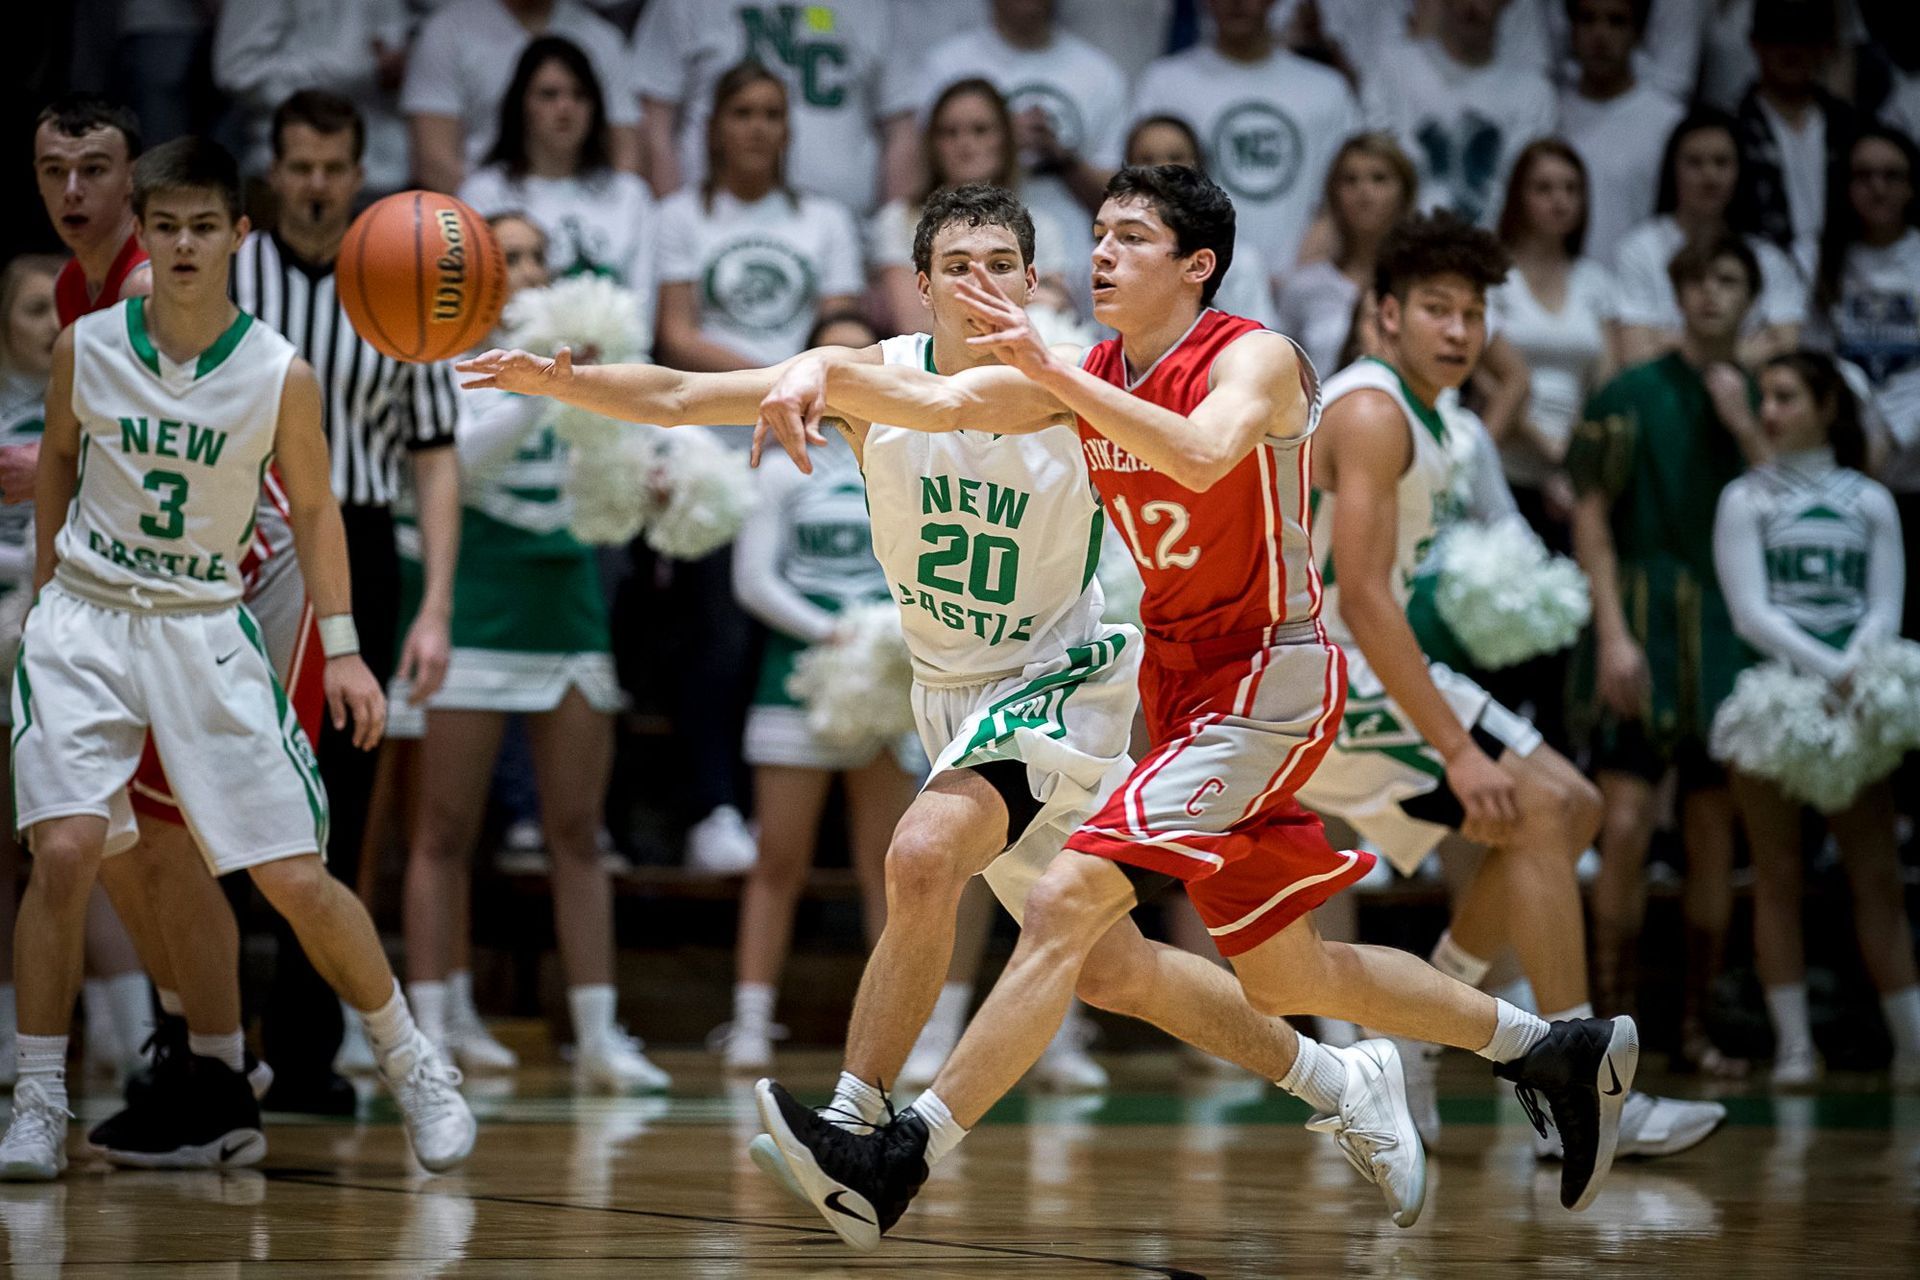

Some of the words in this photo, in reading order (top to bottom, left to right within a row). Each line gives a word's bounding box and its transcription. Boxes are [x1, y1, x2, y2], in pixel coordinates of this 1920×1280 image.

[433, 209, 465, 323] Wilson
[118, 416, 228, 468] NEW
[139, 467, 189, 540] 3
[920, 475, 1030, 530] NEW
[1112, 494, 1201, 570] 12
[917, 522, 1020, 606] 20
